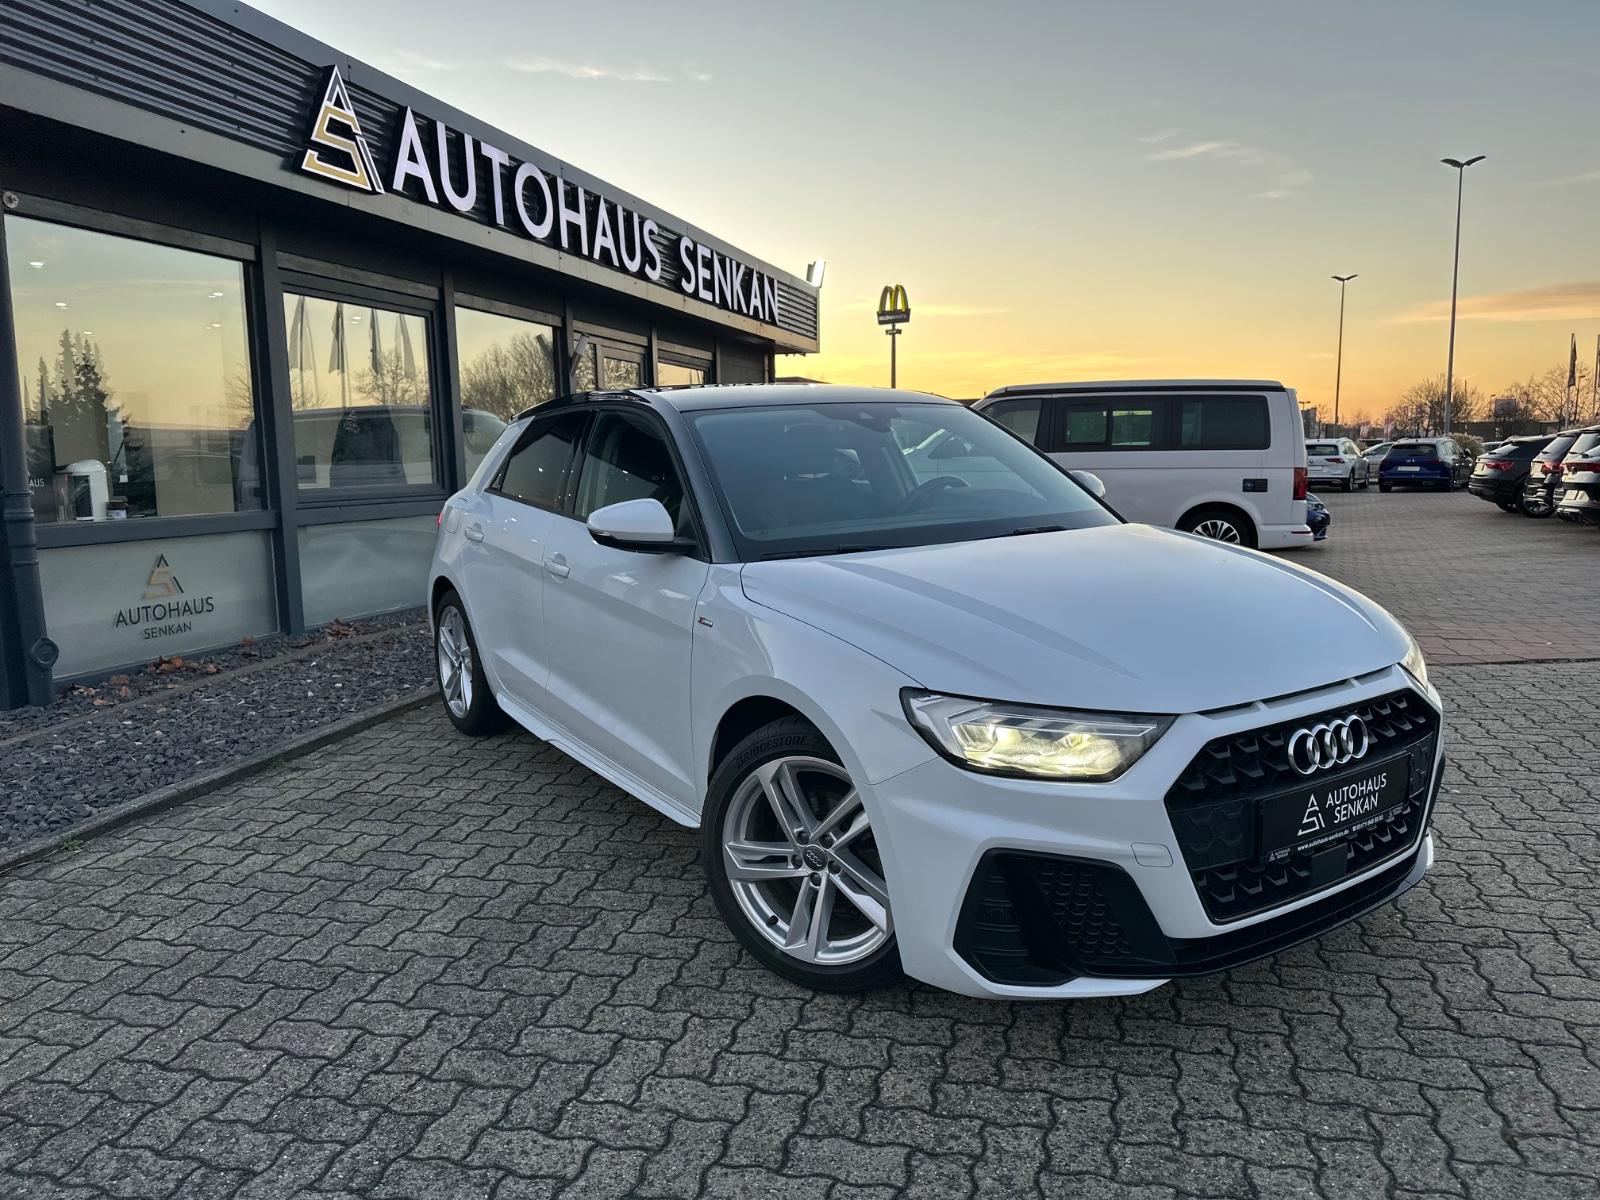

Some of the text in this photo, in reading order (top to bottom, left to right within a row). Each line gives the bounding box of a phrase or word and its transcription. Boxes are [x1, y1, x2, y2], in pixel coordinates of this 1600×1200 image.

[393, 106, 779, 325] AUTOHAUS SENKAN
[115, 596, 215, 628] AUTOHAUS
[143, 621, 192, 640] SENKAN
[1326, 773, 1387, 809] AUTOHAUS
[1333, 792, 1379, 824] SENKAN
